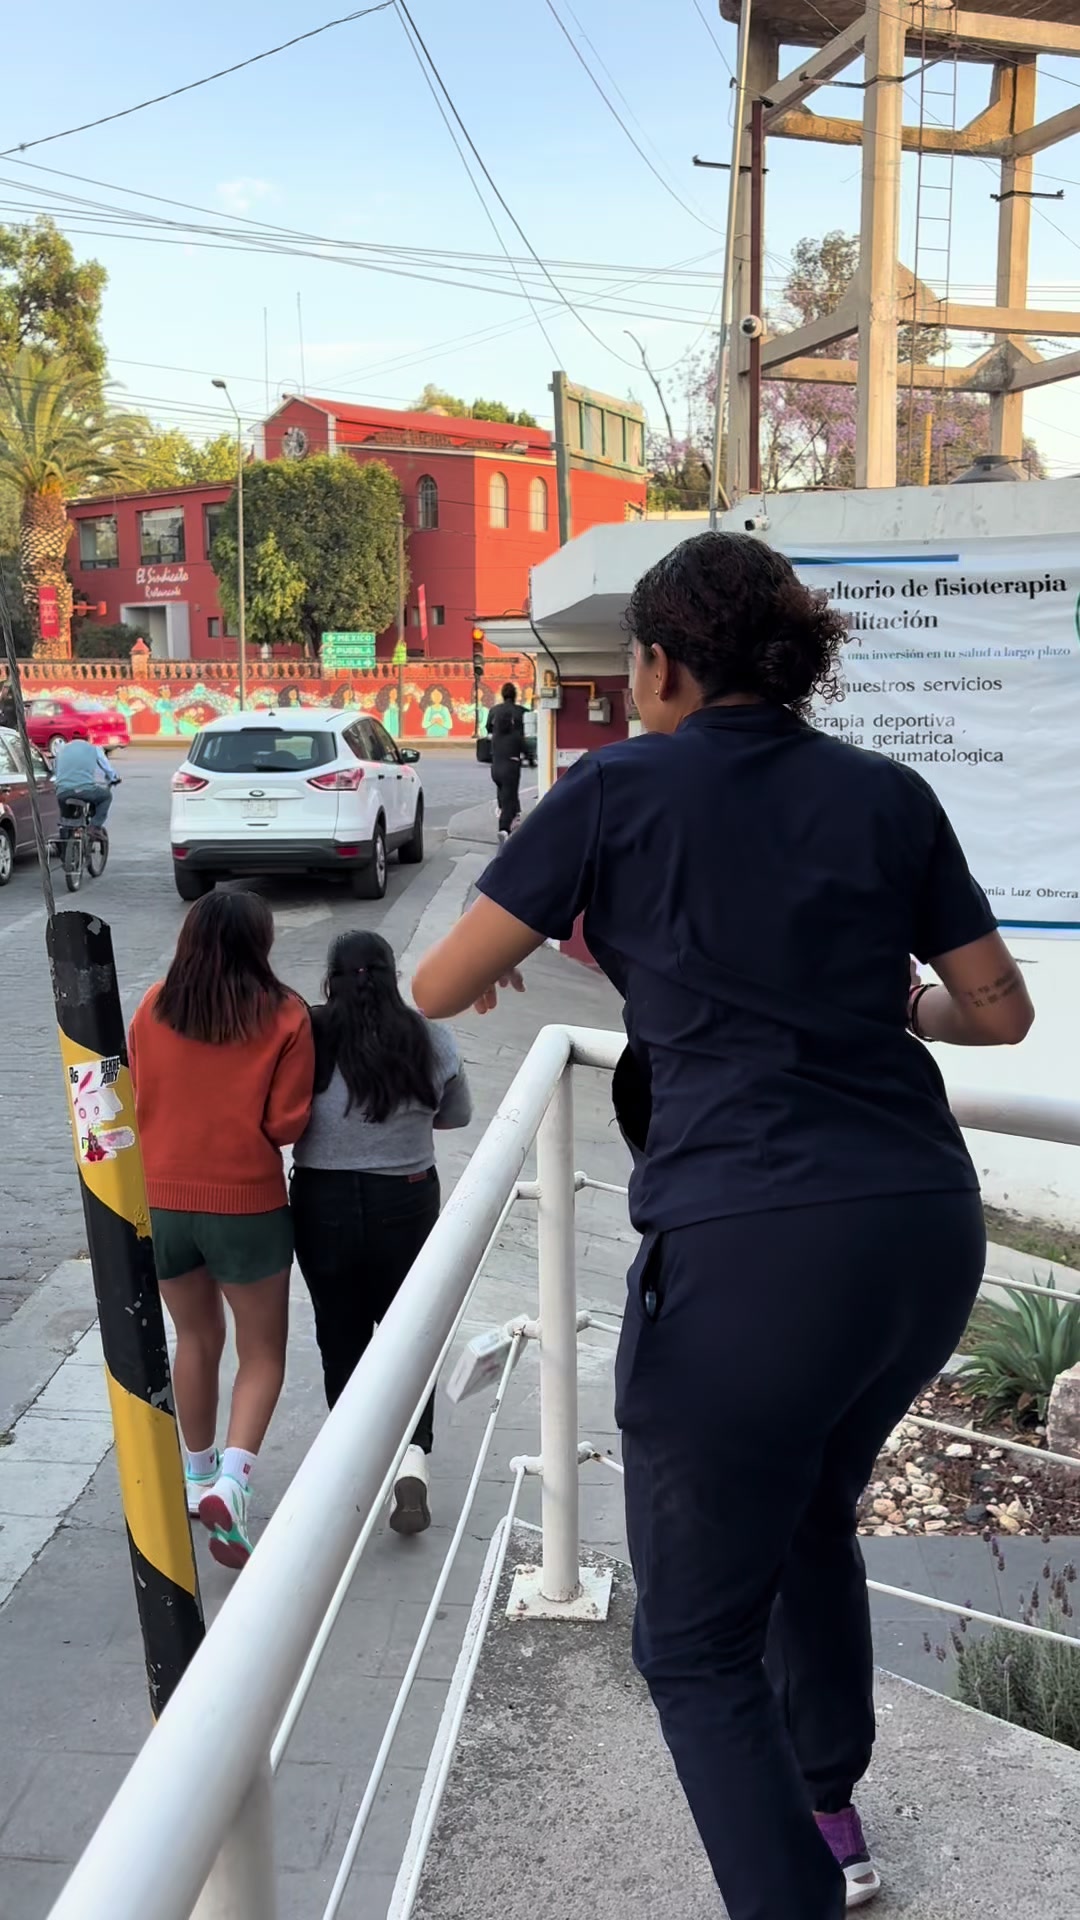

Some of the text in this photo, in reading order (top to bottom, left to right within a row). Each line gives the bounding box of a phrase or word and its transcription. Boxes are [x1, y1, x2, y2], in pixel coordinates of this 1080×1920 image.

[825, 573, 1068, 600] ultorio de fisioterapia
[849, 610, 939, 631] litación
[872, 648, 924, 660] inversión
[926, 650, 941, 659] en
[943, 649, 956, 659] tu
[958, 647, 991, 658] salud
[1003, 646, 1035, 660] largo
[1037, 645, 1071, 660] plazo
[922, 676, 1003, 692] servicios
[813, 713, 955, 731] erapia deportiva
[871, 730, 954, 748] geriatrica
[887, 748, 1004, 766] aumatologica
[1011, 887, 1031, 898] Luz
[1036, 887, 1079, 899] Obrera
